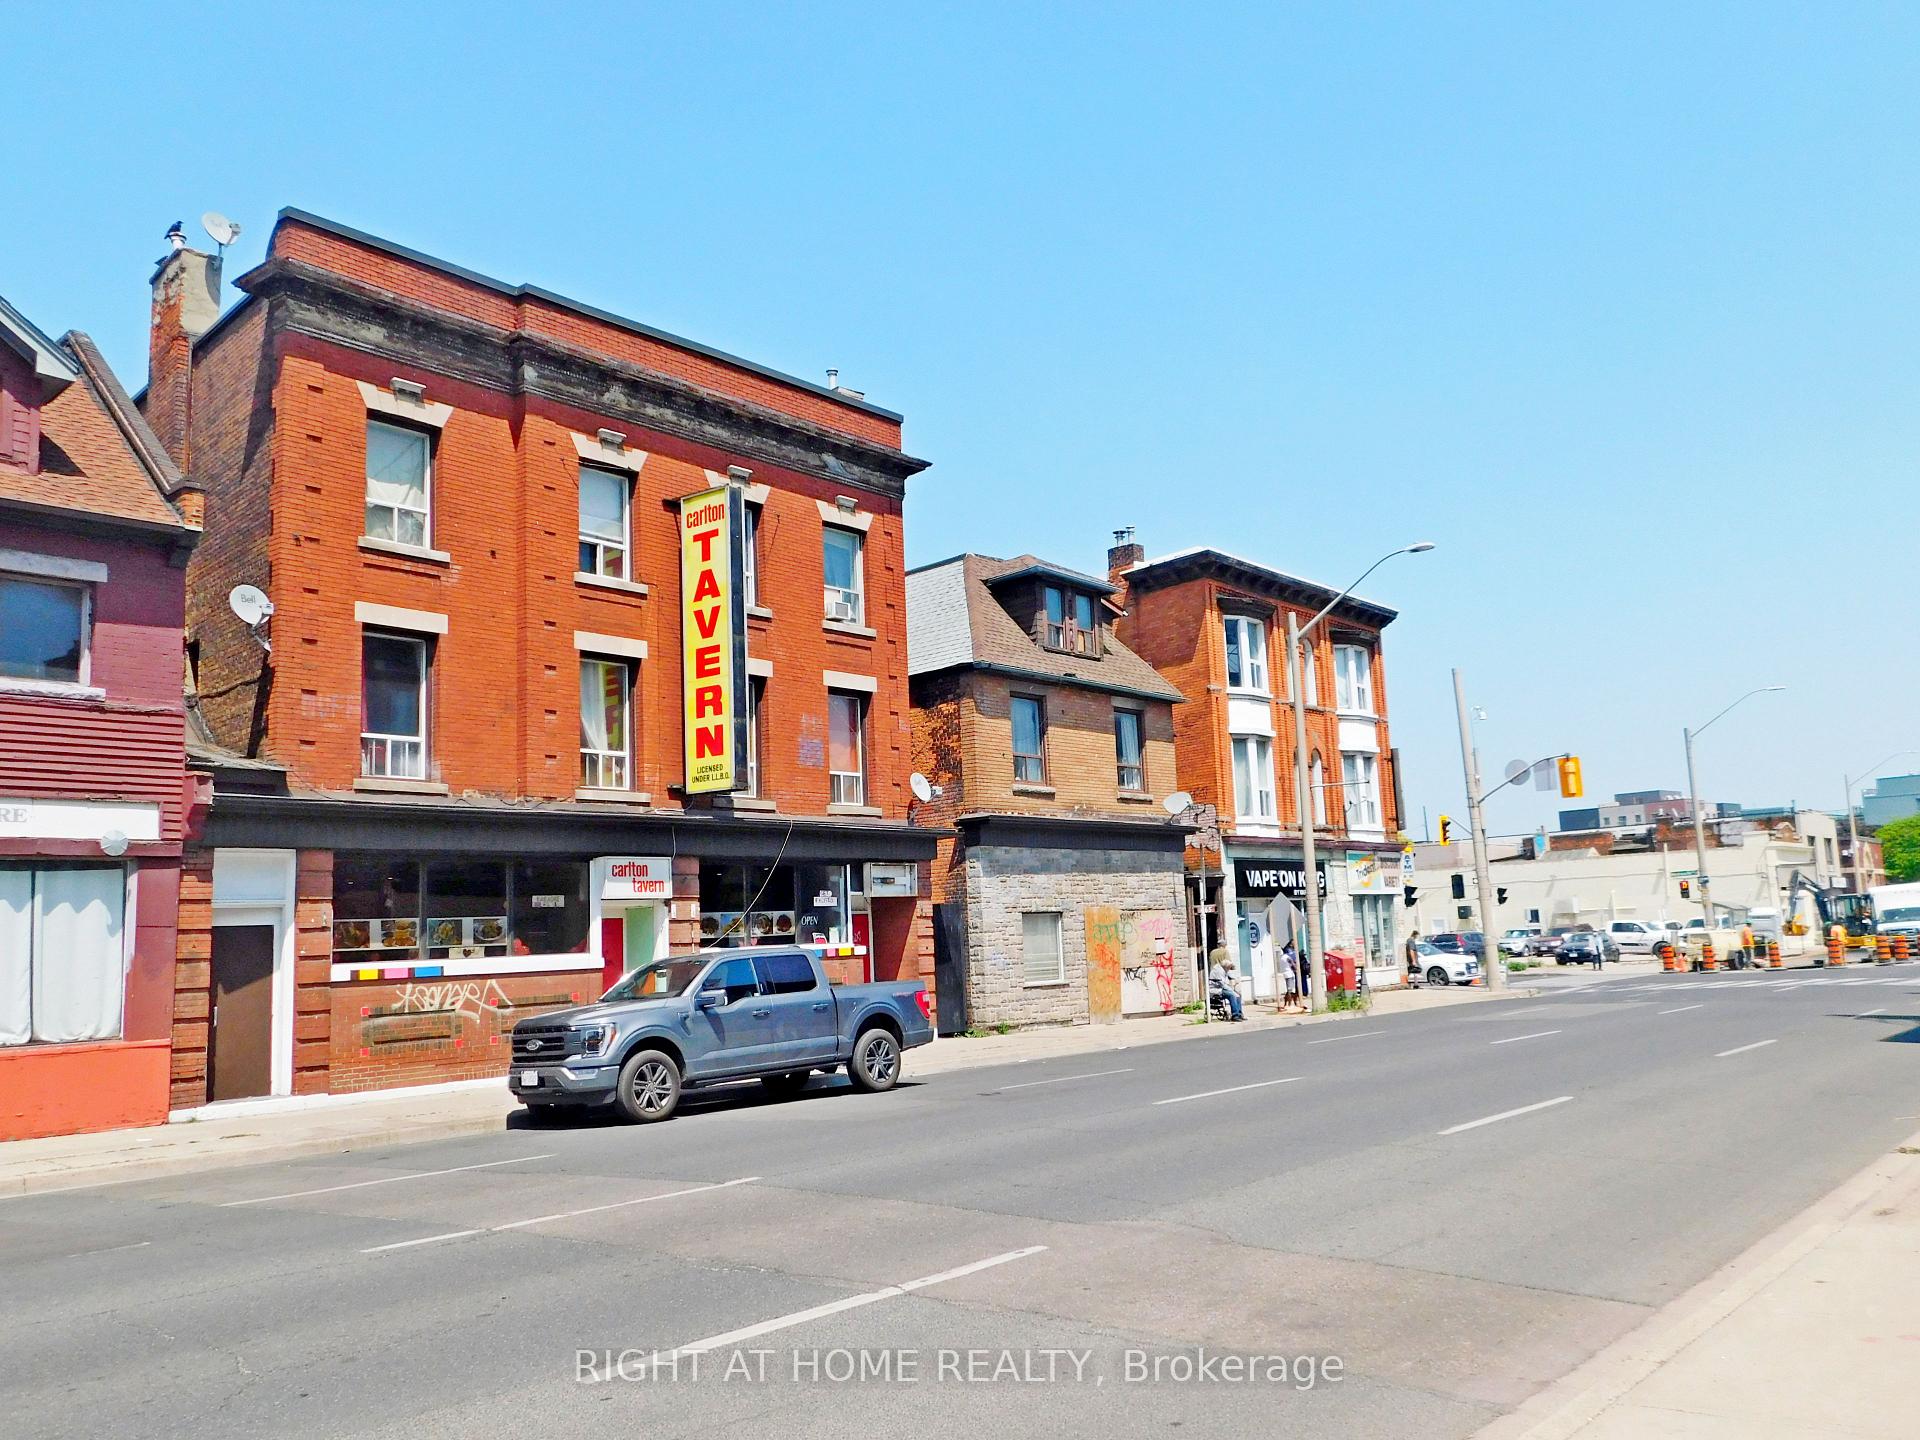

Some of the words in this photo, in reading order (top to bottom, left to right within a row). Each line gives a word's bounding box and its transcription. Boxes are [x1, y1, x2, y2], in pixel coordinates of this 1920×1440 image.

[686, 503, 725, 529] carlton
[240, 593, 256, 604] Bell
[693, 528, 724, 759] TAVERN
[696, 763, 723, 774] LICENSED
[691, 774, 710, 783] UNDER
[0, 807, 28, 823] RE
[611, 861, 649, 877] carlton
[631, 877, 665, 893] tavern
[1245, 869, 1278, 888] VAPE
[1279, 869, 1296, 888] ON
[1297, 870, 1325, 888] KG
[801, 915, 819, 926] OPEN
